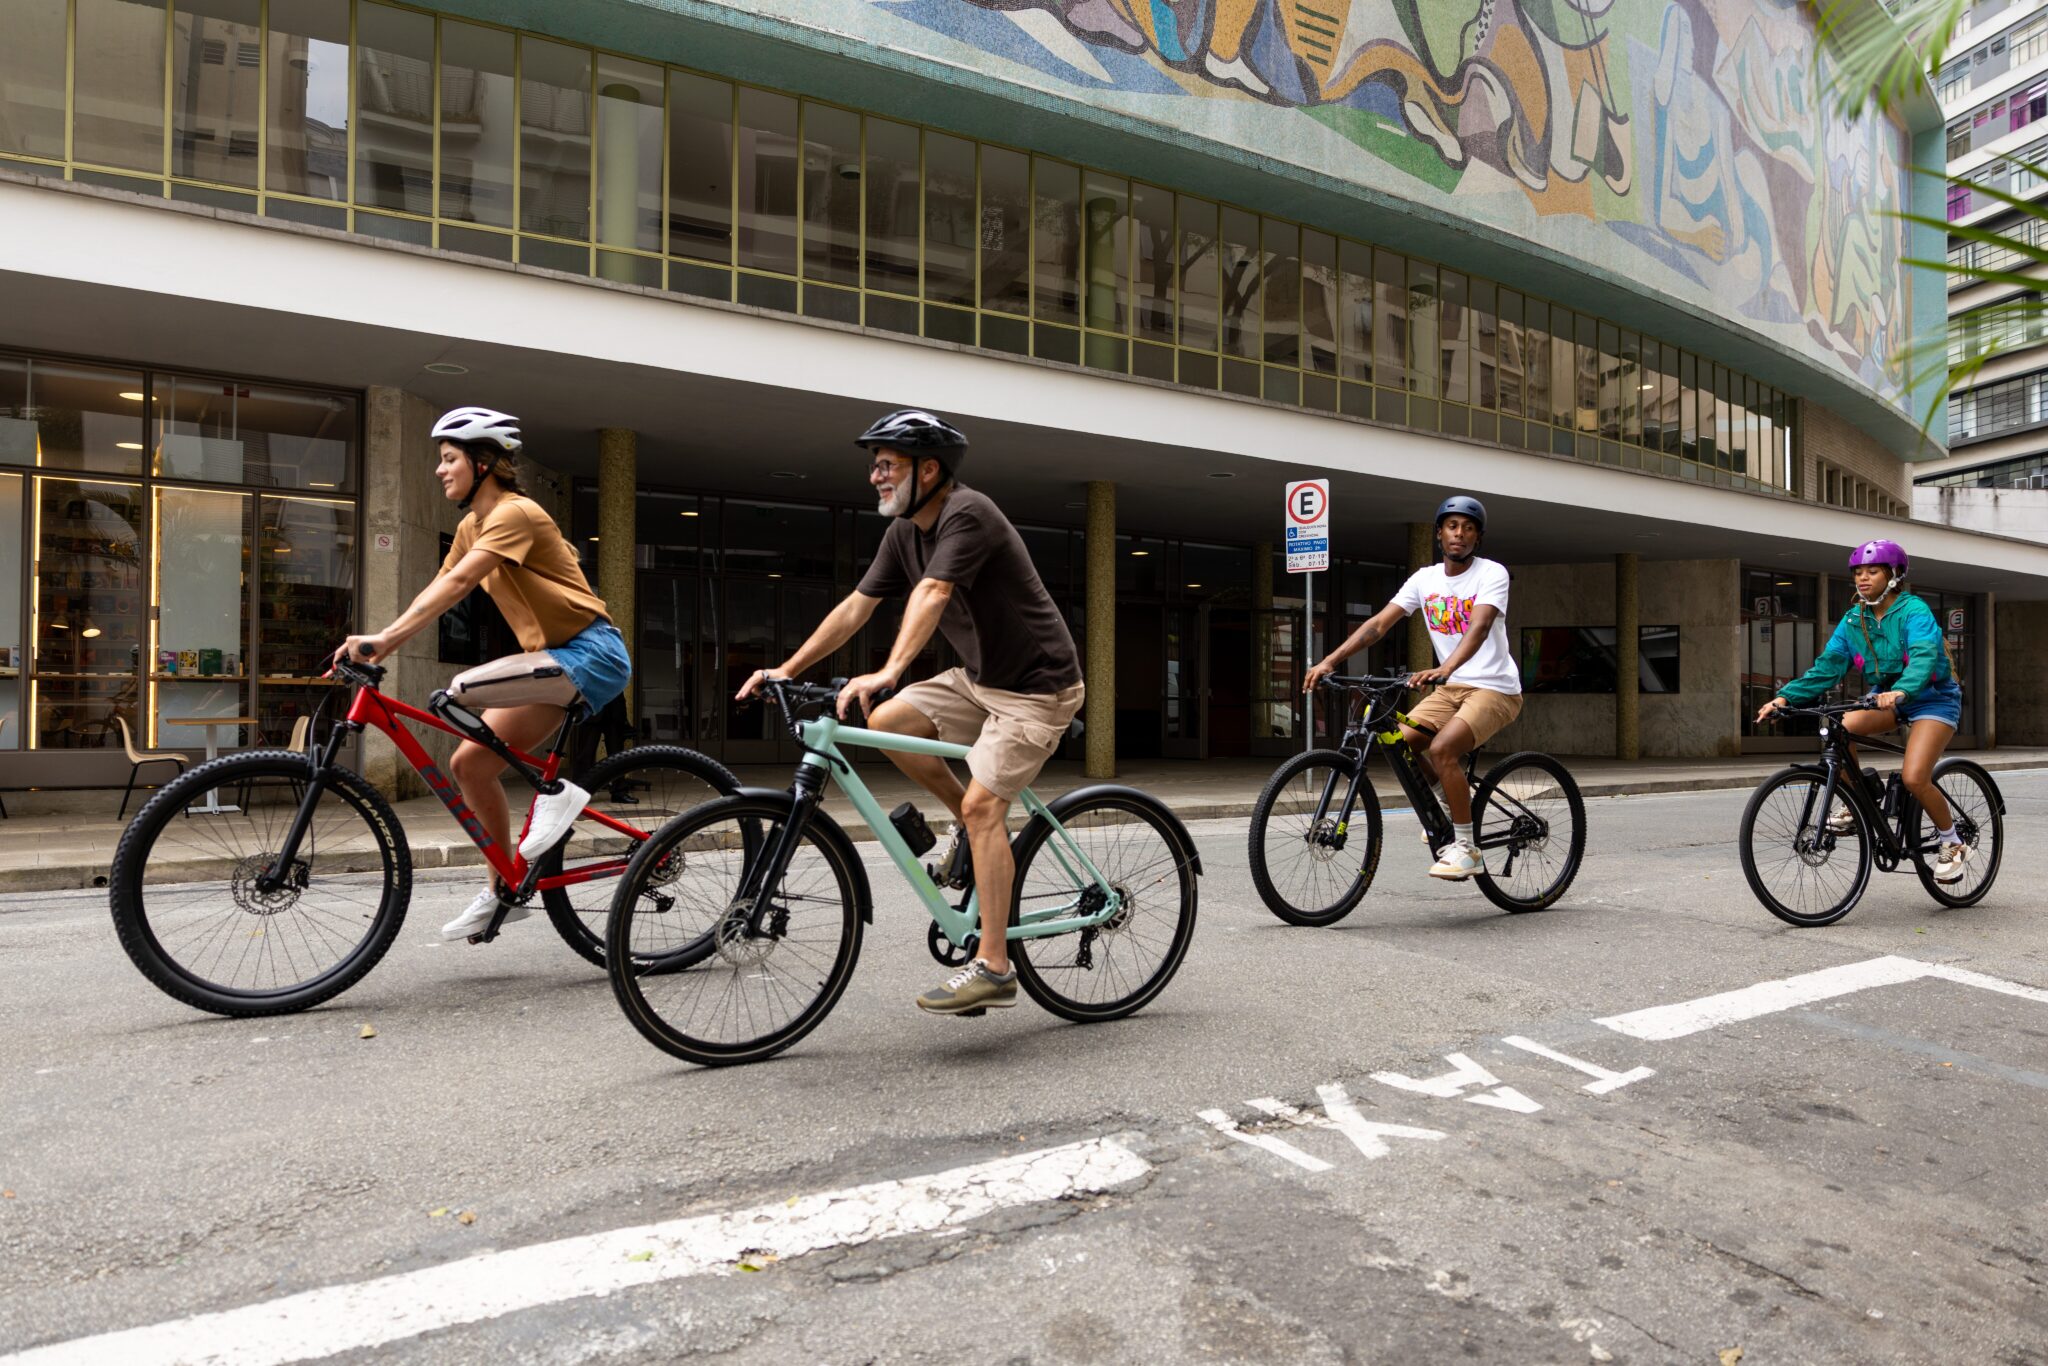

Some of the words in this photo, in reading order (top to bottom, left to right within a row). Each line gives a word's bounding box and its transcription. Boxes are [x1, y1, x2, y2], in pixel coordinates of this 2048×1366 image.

[1300, 491, 1314, 515] E
[360, 798, 395, 848] BARZO
[420, 765, 494, 849] CALOI
[1198, 1035, 1657, 1171] TAXI
